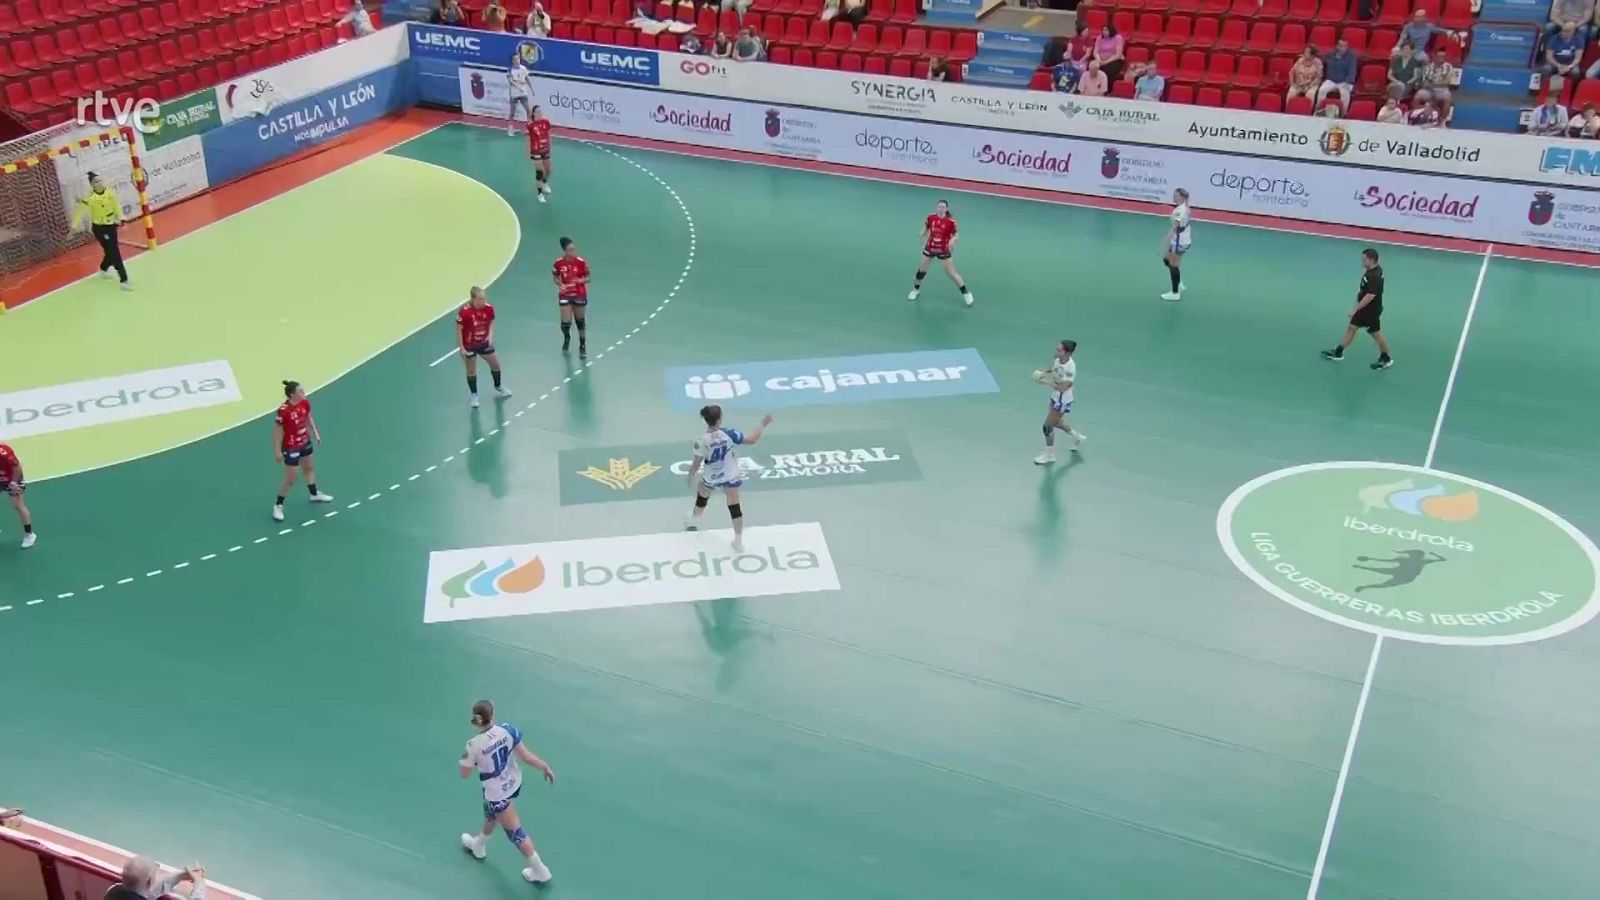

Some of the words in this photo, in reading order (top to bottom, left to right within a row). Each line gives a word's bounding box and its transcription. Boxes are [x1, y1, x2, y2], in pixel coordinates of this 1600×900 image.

[415, 31, 481, 50] UEMC
[580, 50, 651, 70] UEMC
[851, 80, 936, 103] SYNERGIA
[951, 95, 1002, 107] CASTILLA
[1007, 101, 1015, 110] Y
[258, 104, 323, 140] CASTILLA
[328, 98, 337, 117] Y
[343, 83, 376, 110] LEÓN
[655, 104, 732, 132] Sociedad
[1086, 107, 1115, 117] CAJA
[1119, 109, 1160, 121] RURAL
[855, 128, 932, 157] deporte
[1188, 121, 1309, 146] Ayuntamiento
[1358, 138, 1380, 153] de
[1386, 140, 1480, 162] Valladolid
[979, 144, 1072, 174] Sociedad
[1209, 168, 1305, 199] deporte
[1353, 189, 1365, 201] La
[1360, 185, 1480, 218] Sociedad
[765, 363, 968, 393] cajamar
[0, 376, 226, 425] berdrola
[760, 463, 866, 480] ZAMORA
[770, 446, 900, 469] RURAL
[1343, 515, 1474, 553] Iberdrola
[562, 545, 820, 588] Iberdrola
[1251, 531, 1281, 563] LIGA
[1274, 562, 1424, 624] GUERRERAS
[1431, 588, 1565, 626] IBERDROLA
